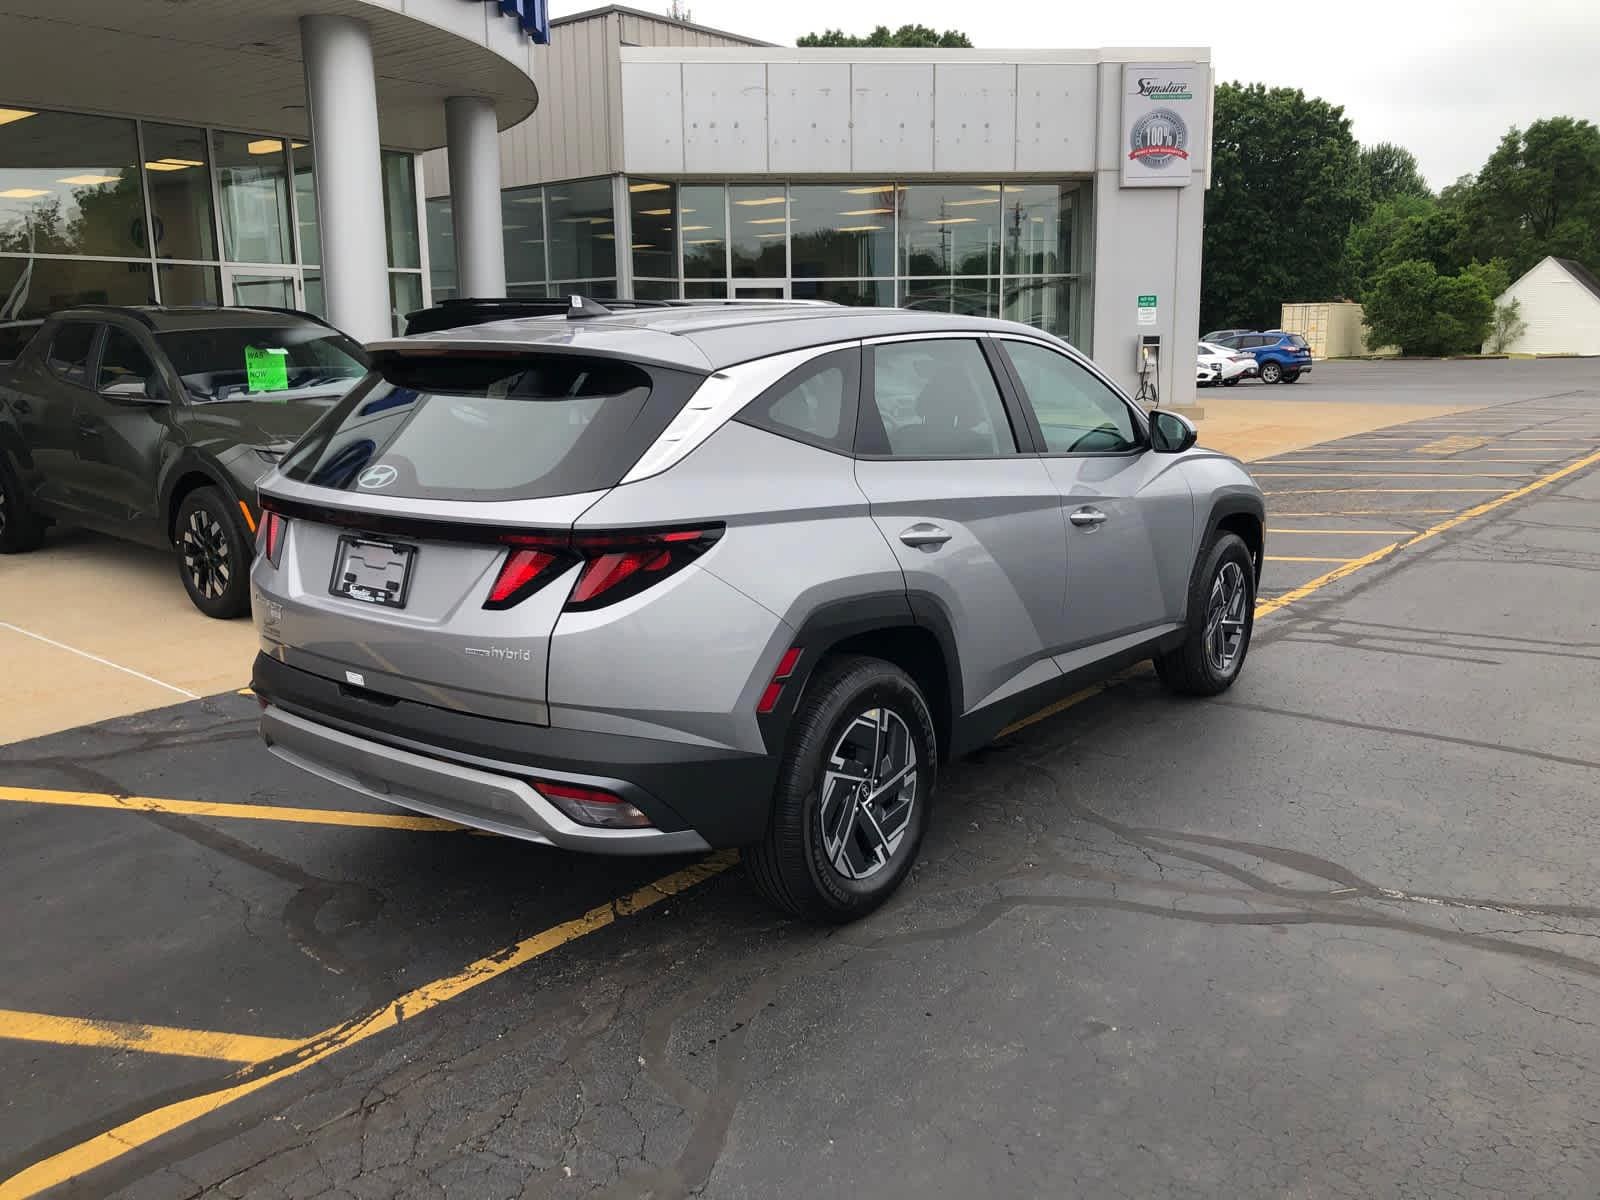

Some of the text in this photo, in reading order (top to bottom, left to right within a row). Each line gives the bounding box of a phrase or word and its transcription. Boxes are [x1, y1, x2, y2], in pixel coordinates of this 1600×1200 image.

[1136, 78, 1187, 96] Signature
[1146, 127, 1173, 146] 100%
[248, 351, 264, 360] WAS
[250, 370, 266, 378] NOW
[491, 646, 531, 661] hybrid
